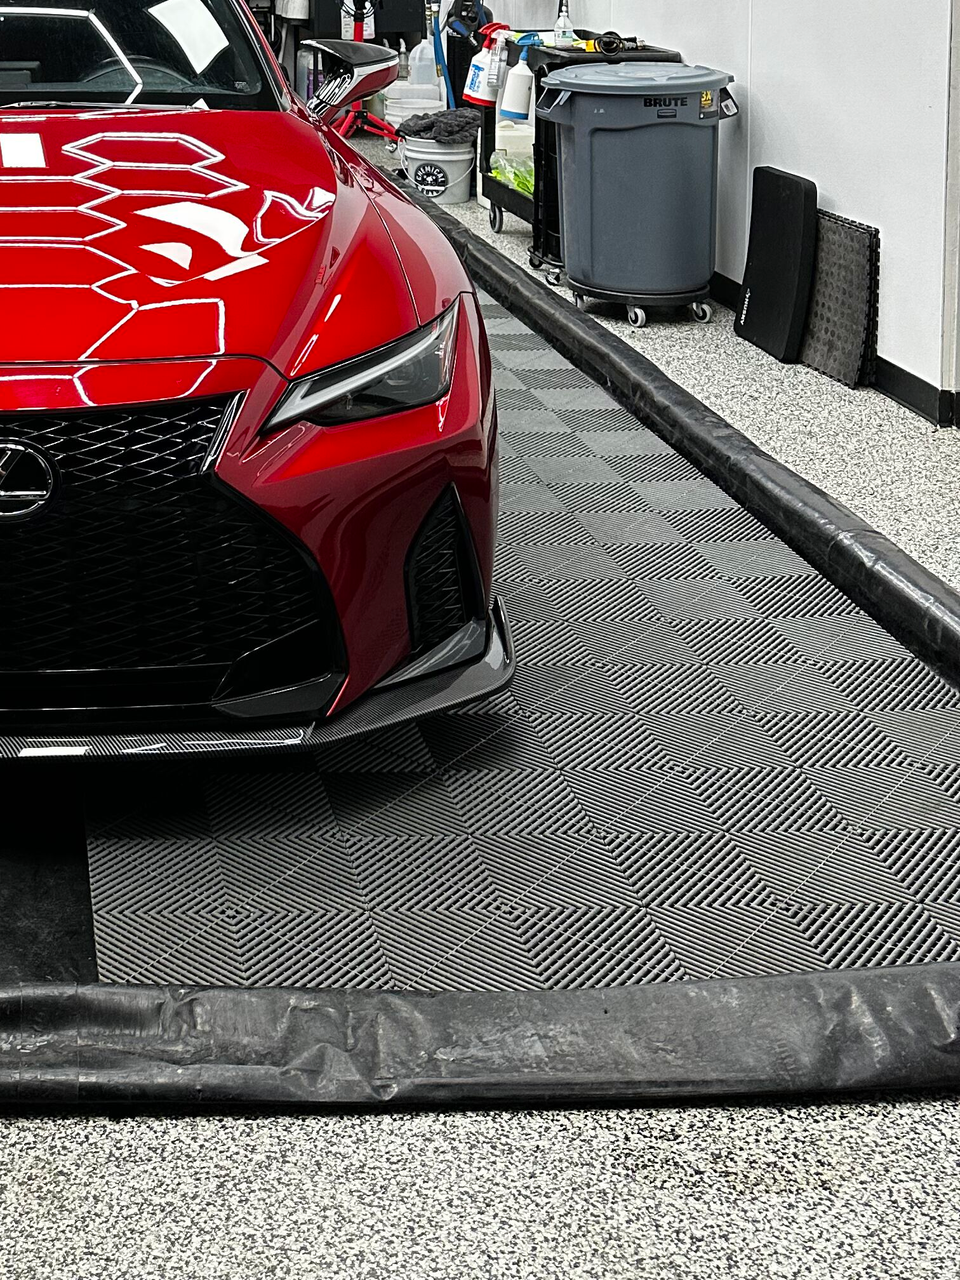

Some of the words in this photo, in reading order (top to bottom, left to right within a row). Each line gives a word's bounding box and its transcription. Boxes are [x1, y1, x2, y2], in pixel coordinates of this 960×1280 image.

[701, 90, 712, 100] 3X
[643, 97, 688, 107] BRUTE
[740, 297, 749, 326] HUSKY
